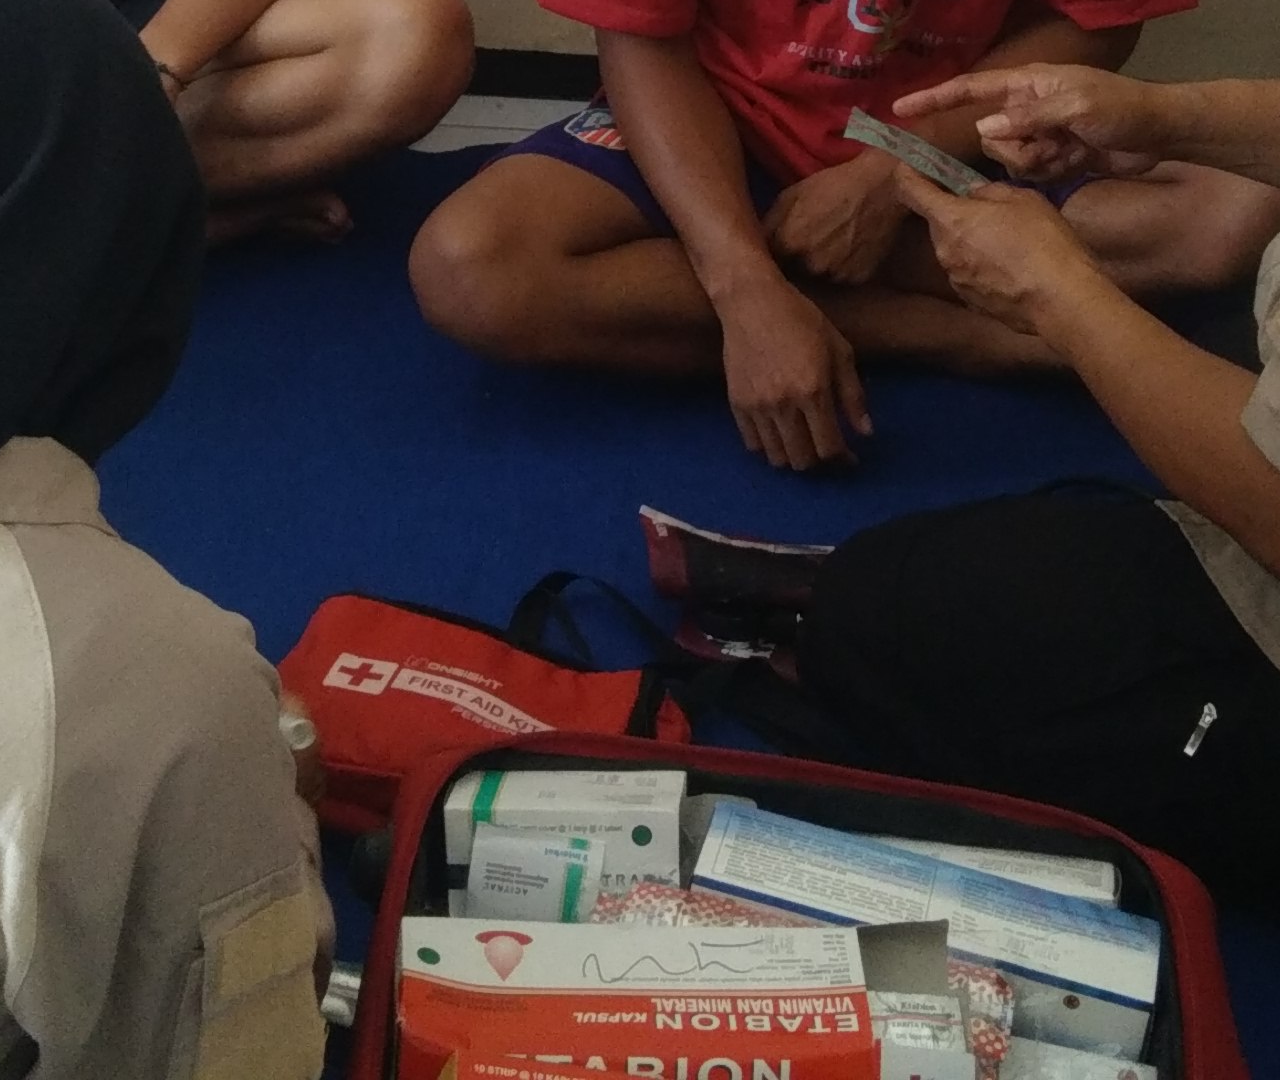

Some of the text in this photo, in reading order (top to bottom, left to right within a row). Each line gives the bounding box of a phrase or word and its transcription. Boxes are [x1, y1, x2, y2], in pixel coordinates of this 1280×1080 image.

[407, 675, 541, 734] FIRST AID KIT
[651, 995, 855, 1014] VITAMIN DAN MINERAL
[573, 1010, 861, 1033] ETABION KAPSUL
